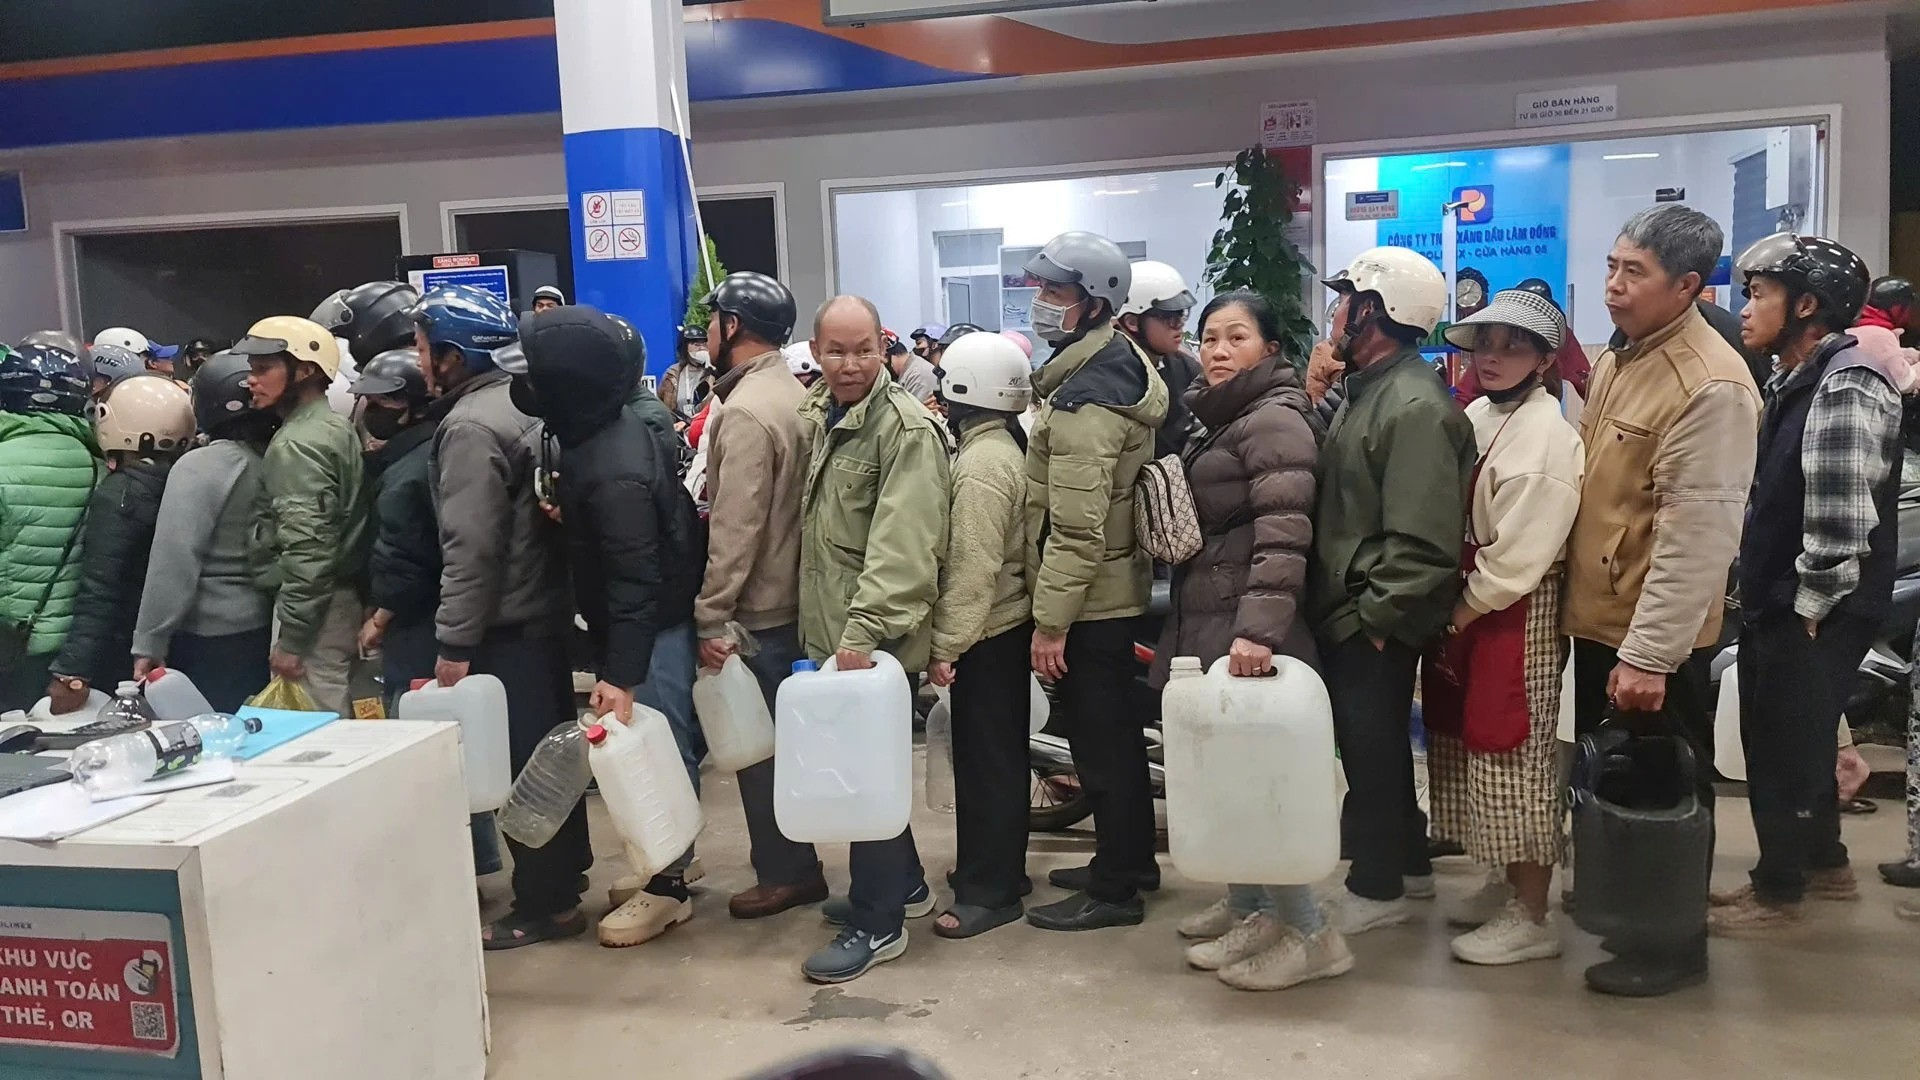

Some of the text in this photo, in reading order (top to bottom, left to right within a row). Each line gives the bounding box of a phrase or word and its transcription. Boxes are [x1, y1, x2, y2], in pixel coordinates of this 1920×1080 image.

[1551, 98, 1571, 107] BÁN
[1573, 96, 1600, 105] HÀNG
[1388, 232, 1412, 247] CÔNG
[1415, 233, 1427, 246] TY
[1457, 229, 1483, 243] XĂNG
[1506, 226, 1527, 240] LÂM
[1501, 245, 1532, 256] HÀNG
[43, 947, 93, 975] VỰC
[0, 977, 121, 1002] ANH TOÁN
[61, 1010, 95, 1030] QR
